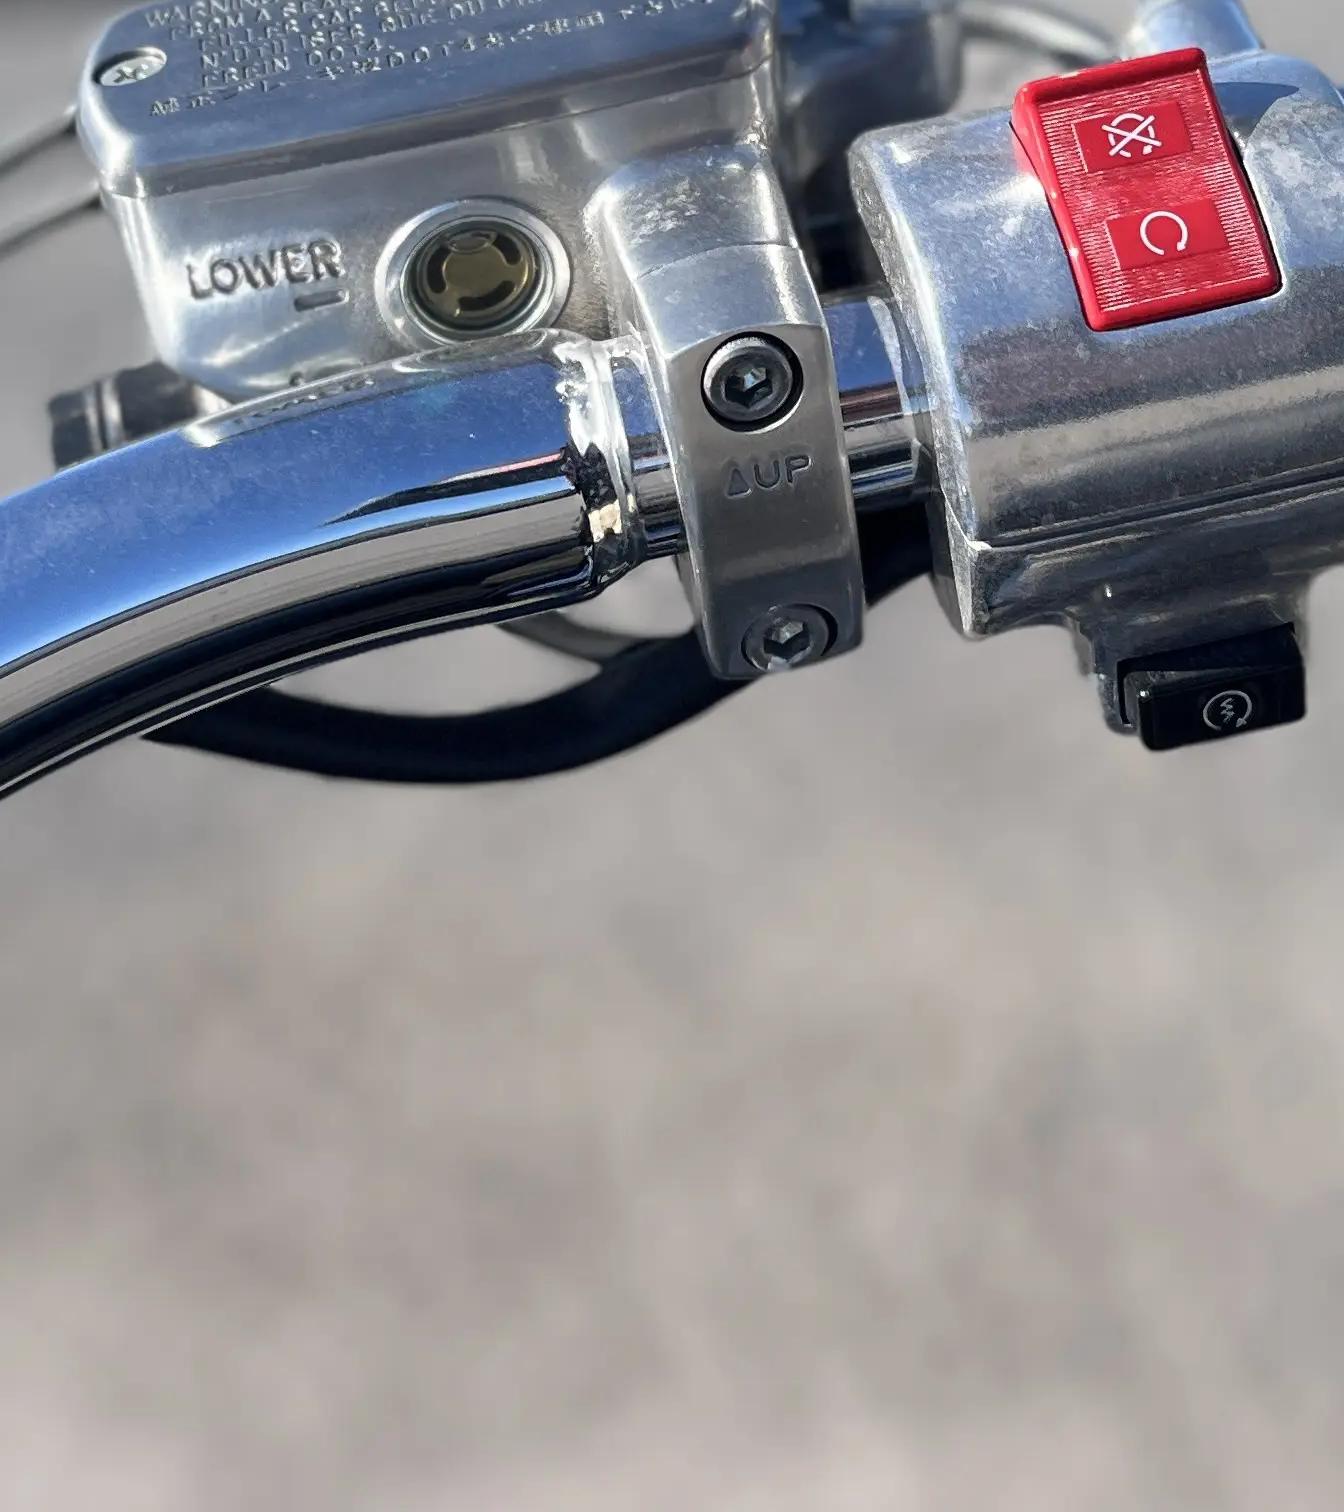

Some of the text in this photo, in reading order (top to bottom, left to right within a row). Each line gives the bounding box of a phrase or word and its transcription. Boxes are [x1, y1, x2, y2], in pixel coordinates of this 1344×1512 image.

[170, 12, 245, 41] FROM
[257, 7, 272, 22] A
[199, 18, 301, 53] FILLER
[311, 4, 364, 30] CAP
[202, 55, 291, 88] FREIN
[186, 238, 344, 300] LOWER
[753, 454, 811, 489] UP
